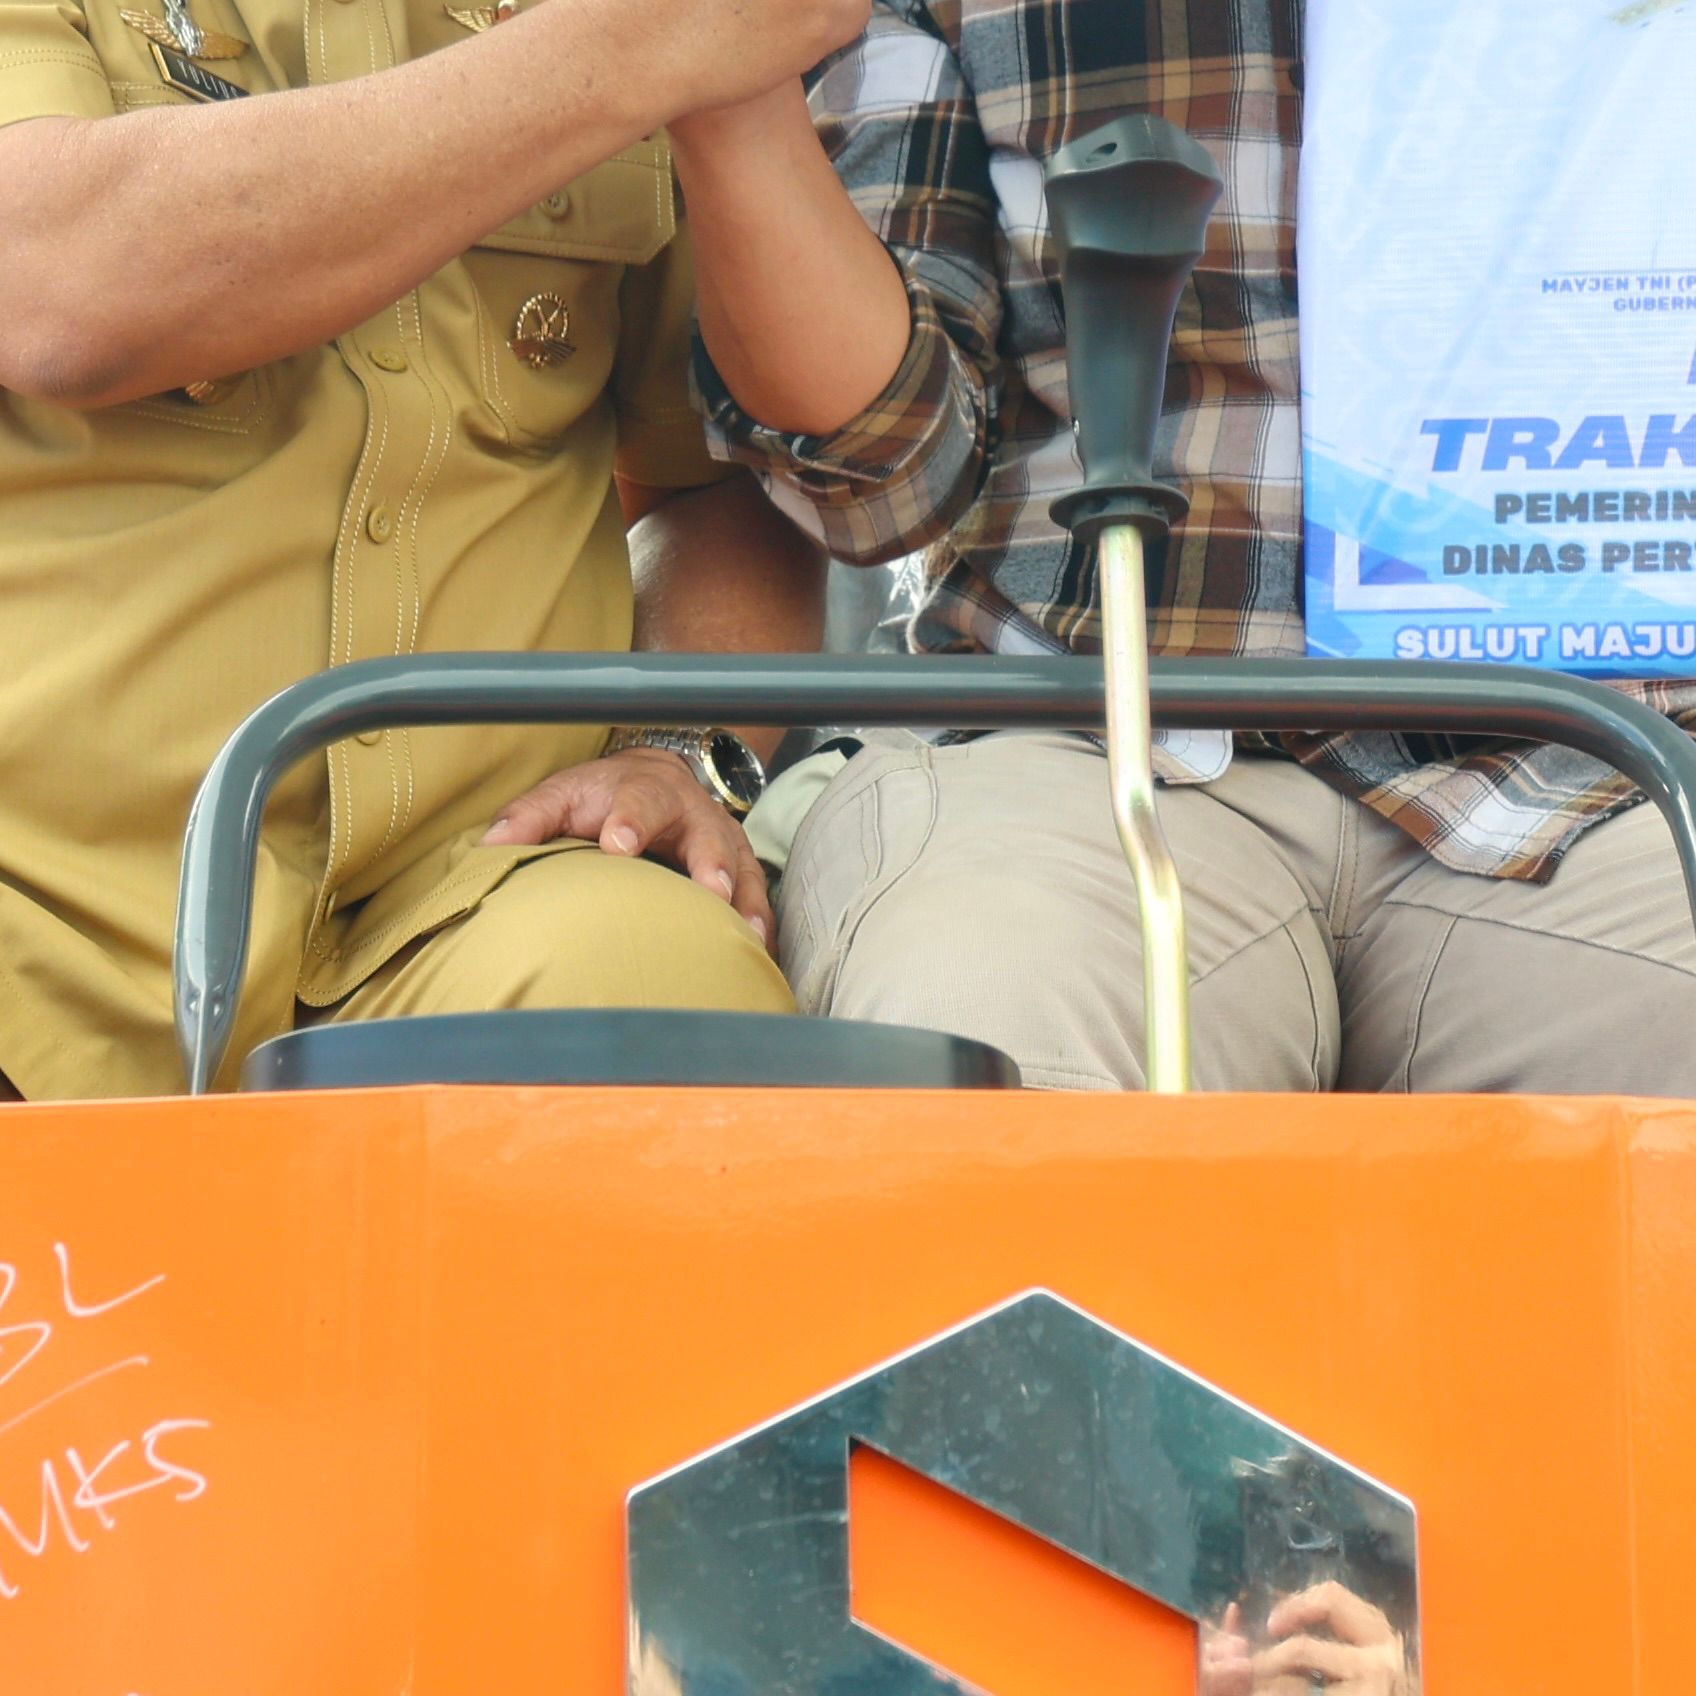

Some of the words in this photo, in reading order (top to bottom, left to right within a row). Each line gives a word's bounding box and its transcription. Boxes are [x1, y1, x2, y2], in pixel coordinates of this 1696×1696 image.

[1541, 277, 1630, 294] MAYJEN
[1636, 276, 1672, 292] TNI
[1443, 543, 1586, 575] DINAS
[1395, 628, 1547, 659] SULUT
[1563, 625, 1696, 657] MAJU
